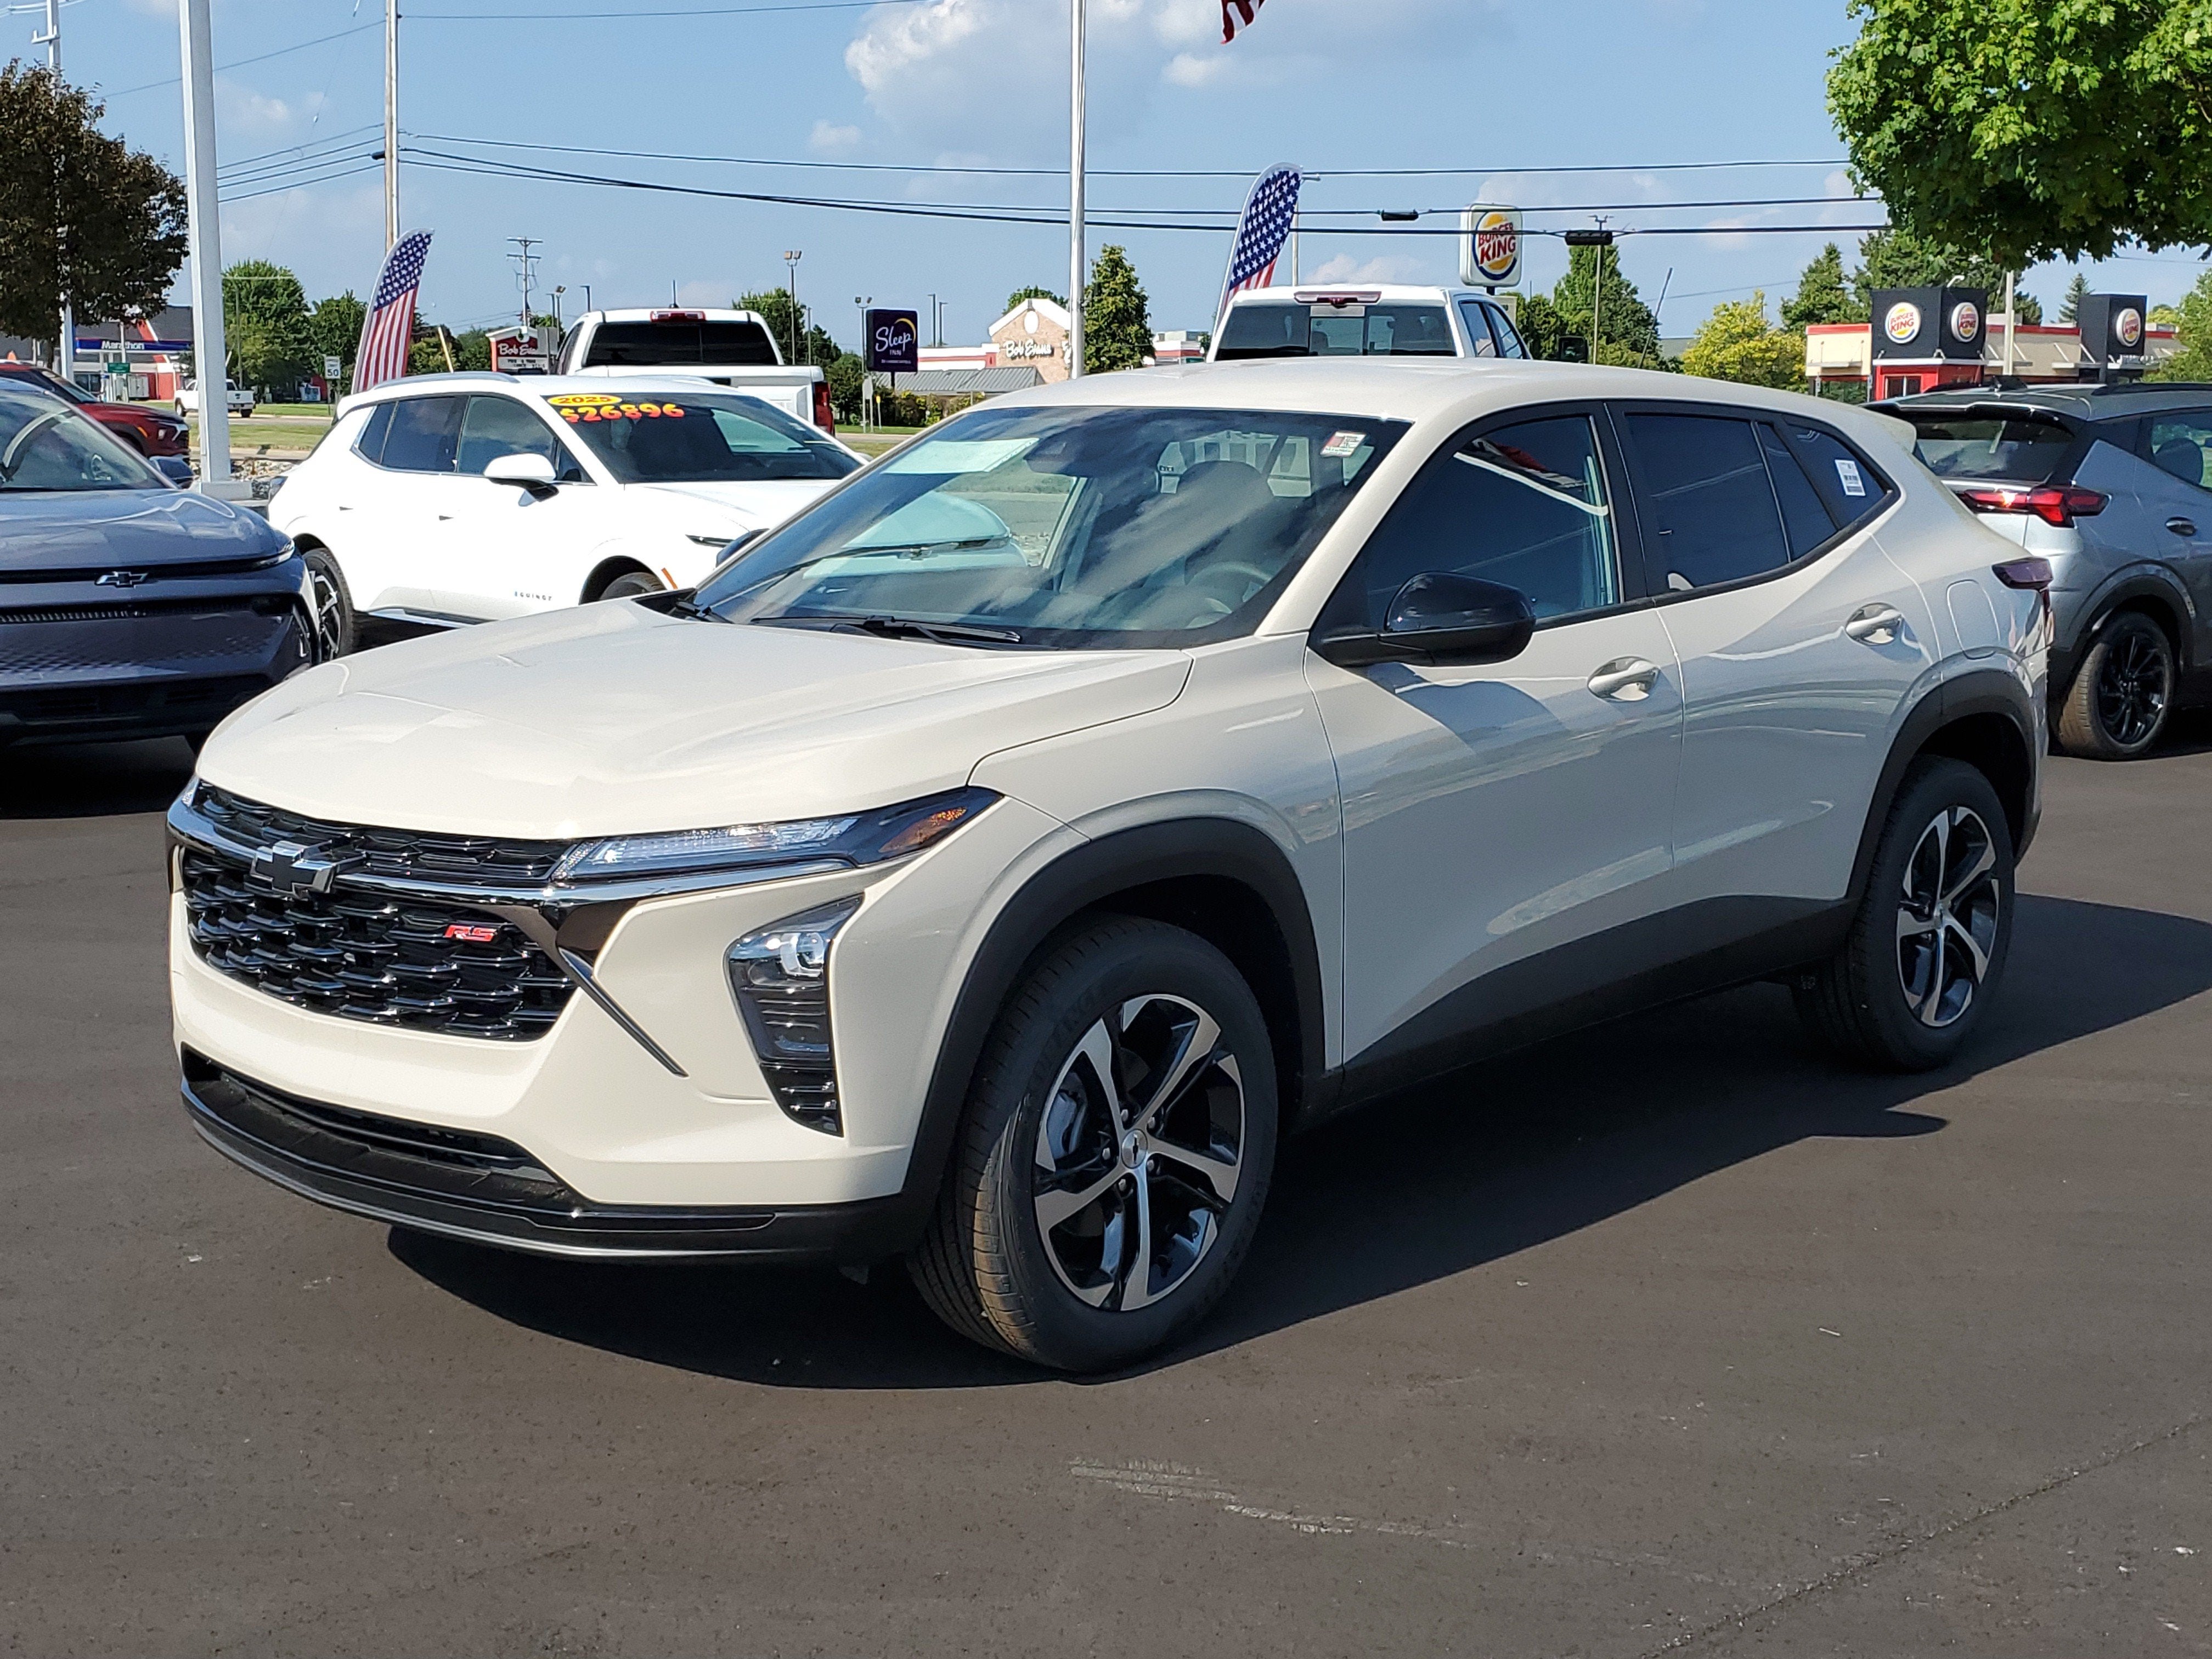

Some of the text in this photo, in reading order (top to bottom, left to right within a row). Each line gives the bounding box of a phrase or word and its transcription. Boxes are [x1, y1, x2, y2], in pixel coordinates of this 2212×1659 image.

[1478, 222, 1513, 245] BURGER
[1479, 236, 1516, 265] KING
[1889, 318, 1915, 333] KING
[1891, 312, 1914, 325] BURGER
[875, 326, 912, 352] Sleep
[1003, 340, 1024, 358] Bob
[1025, 338, 1052, 357] Evans
[498, 343, 518, 356] Bob
[560, 403, 685, 423] $26896
[444, 924, 497, 941] RS
